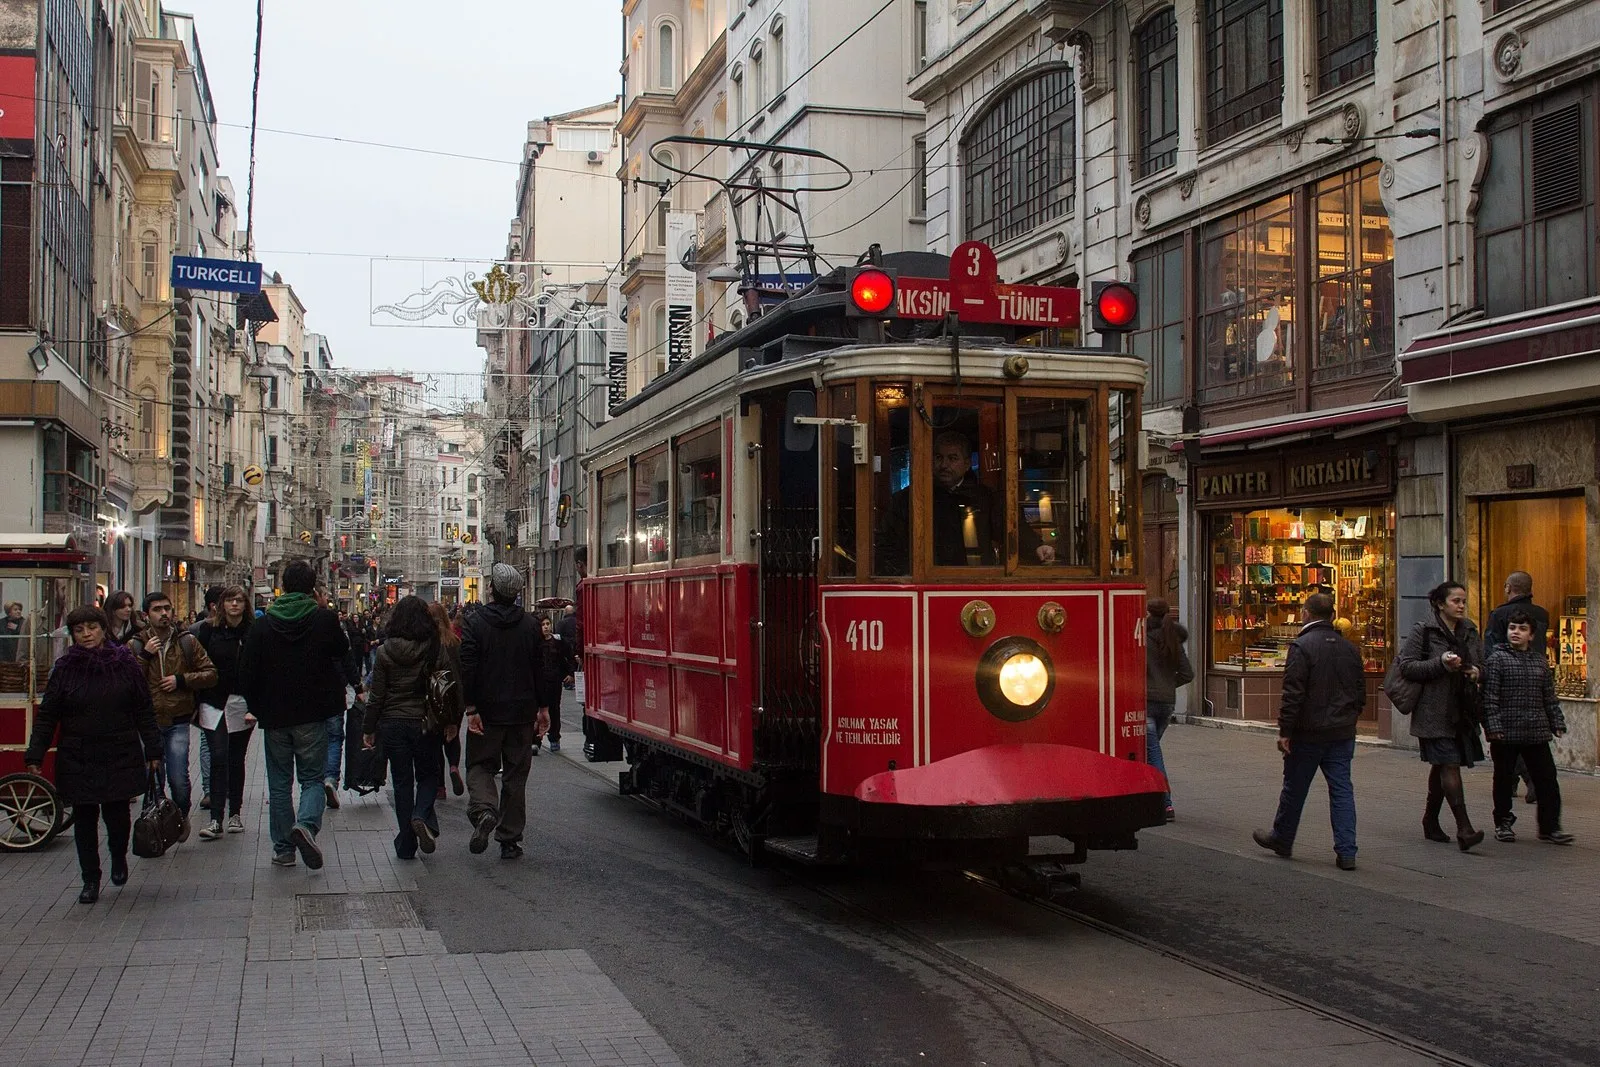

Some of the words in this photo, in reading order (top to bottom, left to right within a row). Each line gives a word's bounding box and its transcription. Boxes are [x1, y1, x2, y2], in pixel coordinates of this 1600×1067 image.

[177, 265, 256, 284] TURKCELL
[967, 247, 981, 277] 3
[897, 286, 950, 316] AKSİM
[998, 290, 1059, 323] TÜNEL
[668, 304, 692, 371] BERTSON
[1200, 470, 1268, 496] PANTER
[846, 620, 884, 652] 410
[1134, 618, 1145, 646] 41
[869, 717, 898, 730] YASAK
[1121, 726, 1131, 737] VE
[836, 731, 843, 743] VE
[845, 731, 901, 745] TEHLİKELİDİR
